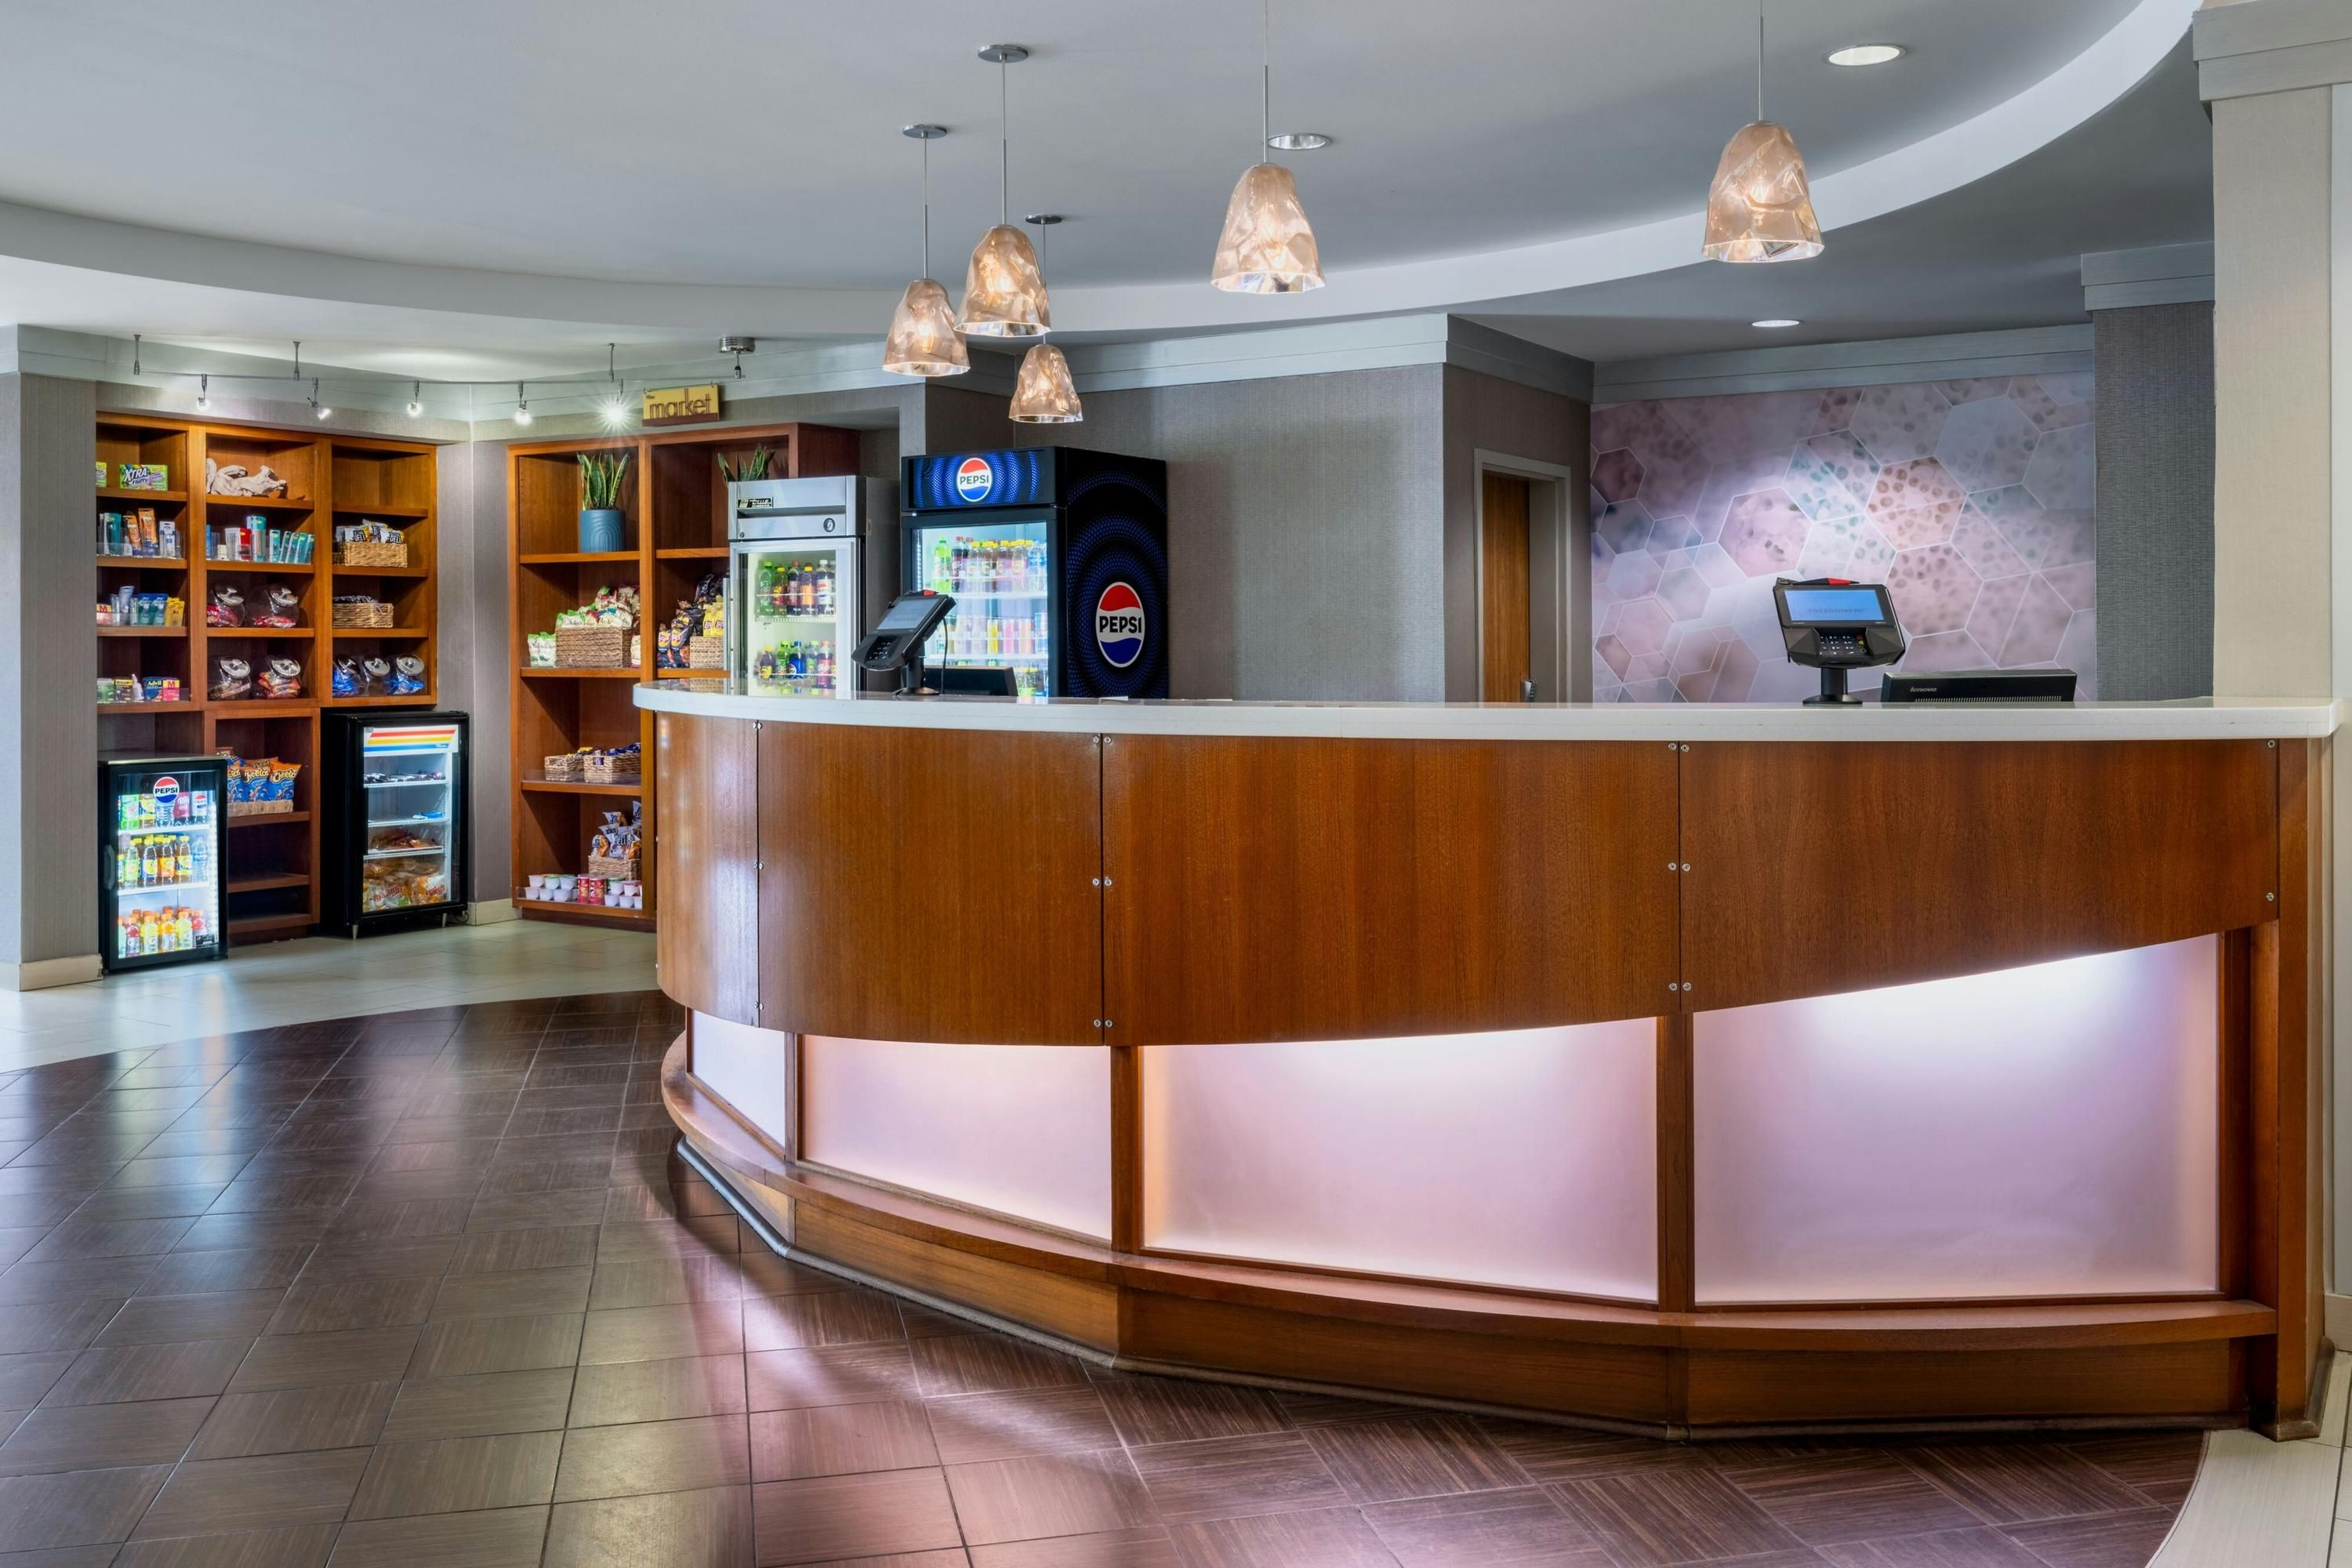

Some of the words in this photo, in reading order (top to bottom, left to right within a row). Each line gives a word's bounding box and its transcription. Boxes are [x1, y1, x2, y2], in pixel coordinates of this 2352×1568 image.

[650, 388, 711, 418] market
[124, 466, 147, 482] XTRA
[960, 474, 989, 485] PEPSI
[1099, 615, 1142, 633] PEPSI
